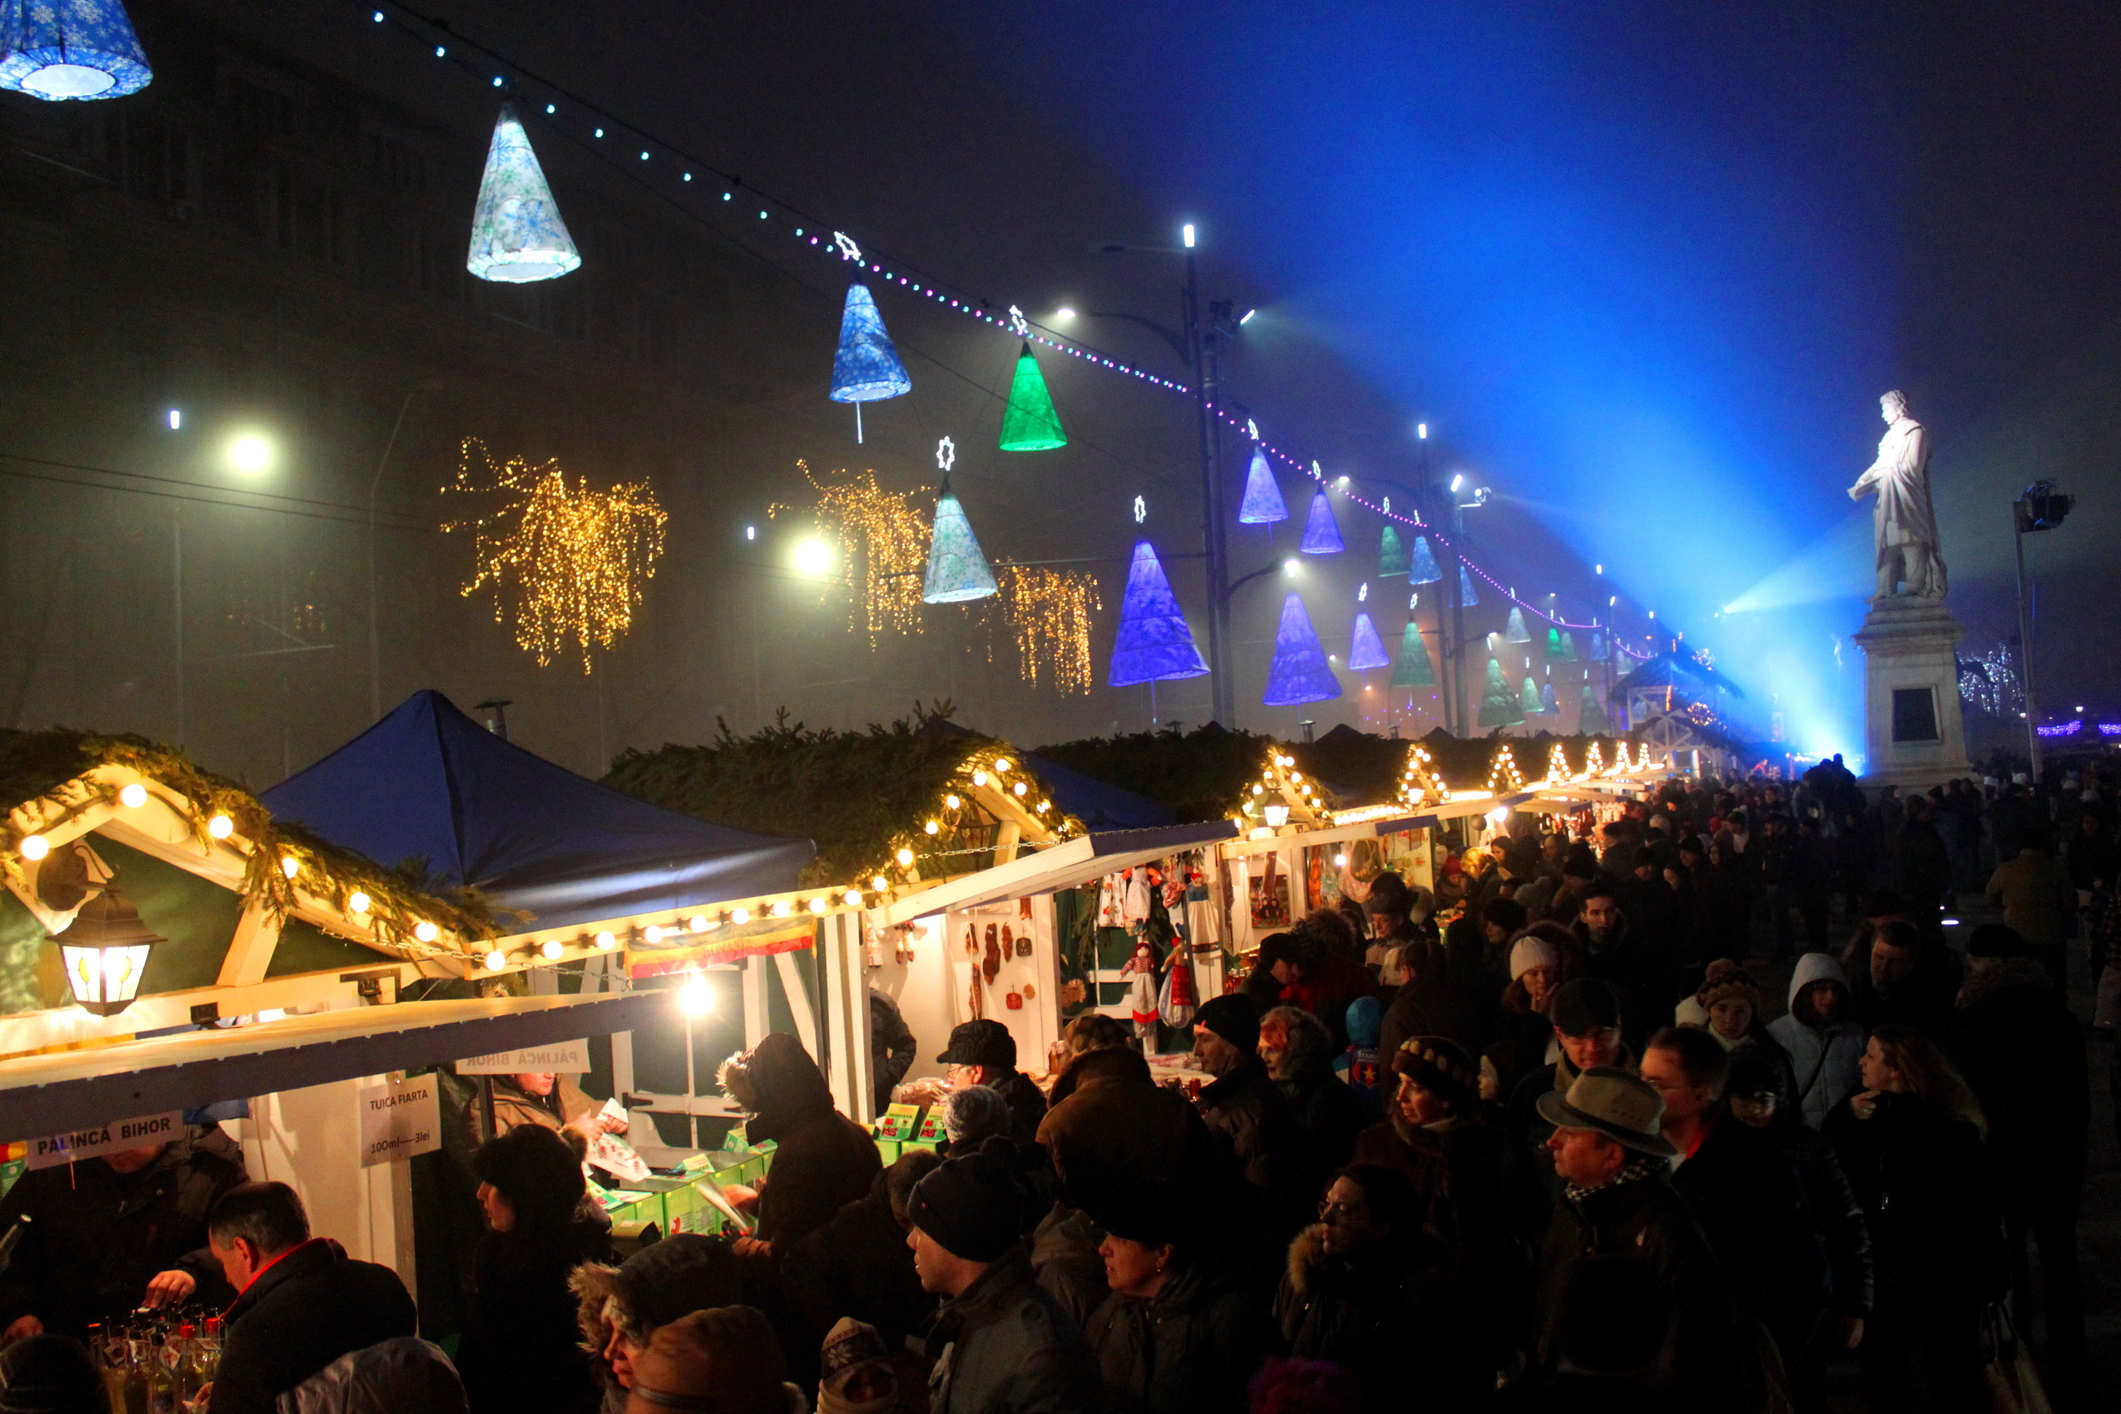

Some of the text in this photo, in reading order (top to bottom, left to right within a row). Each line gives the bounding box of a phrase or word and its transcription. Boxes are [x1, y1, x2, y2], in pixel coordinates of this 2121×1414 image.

[370, 1089, 428, 1111] TUICA FIARTA
[121, 1118, 171, 1140] BIHOR
